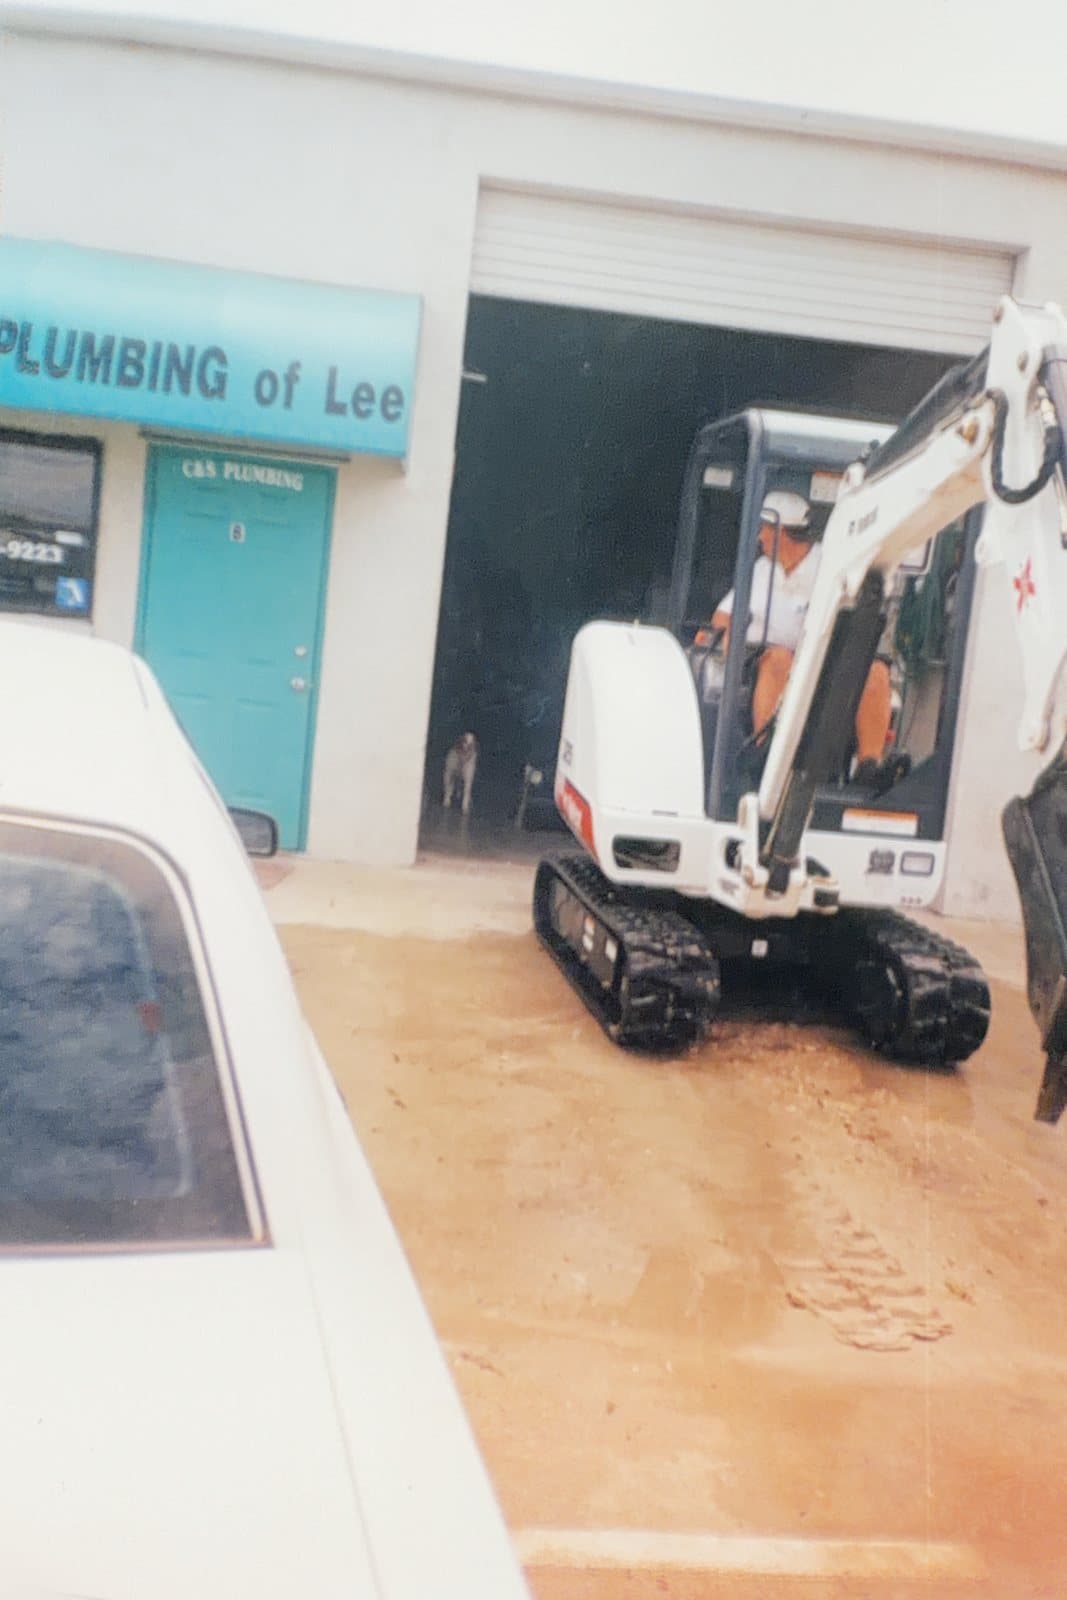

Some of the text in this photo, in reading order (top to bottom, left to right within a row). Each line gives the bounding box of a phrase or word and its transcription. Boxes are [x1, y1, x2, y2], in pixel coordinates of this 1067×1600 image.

[0, 319, 405, 422] PLUMBING of Lee
[224, 461, 304, 491] PLUMBING
